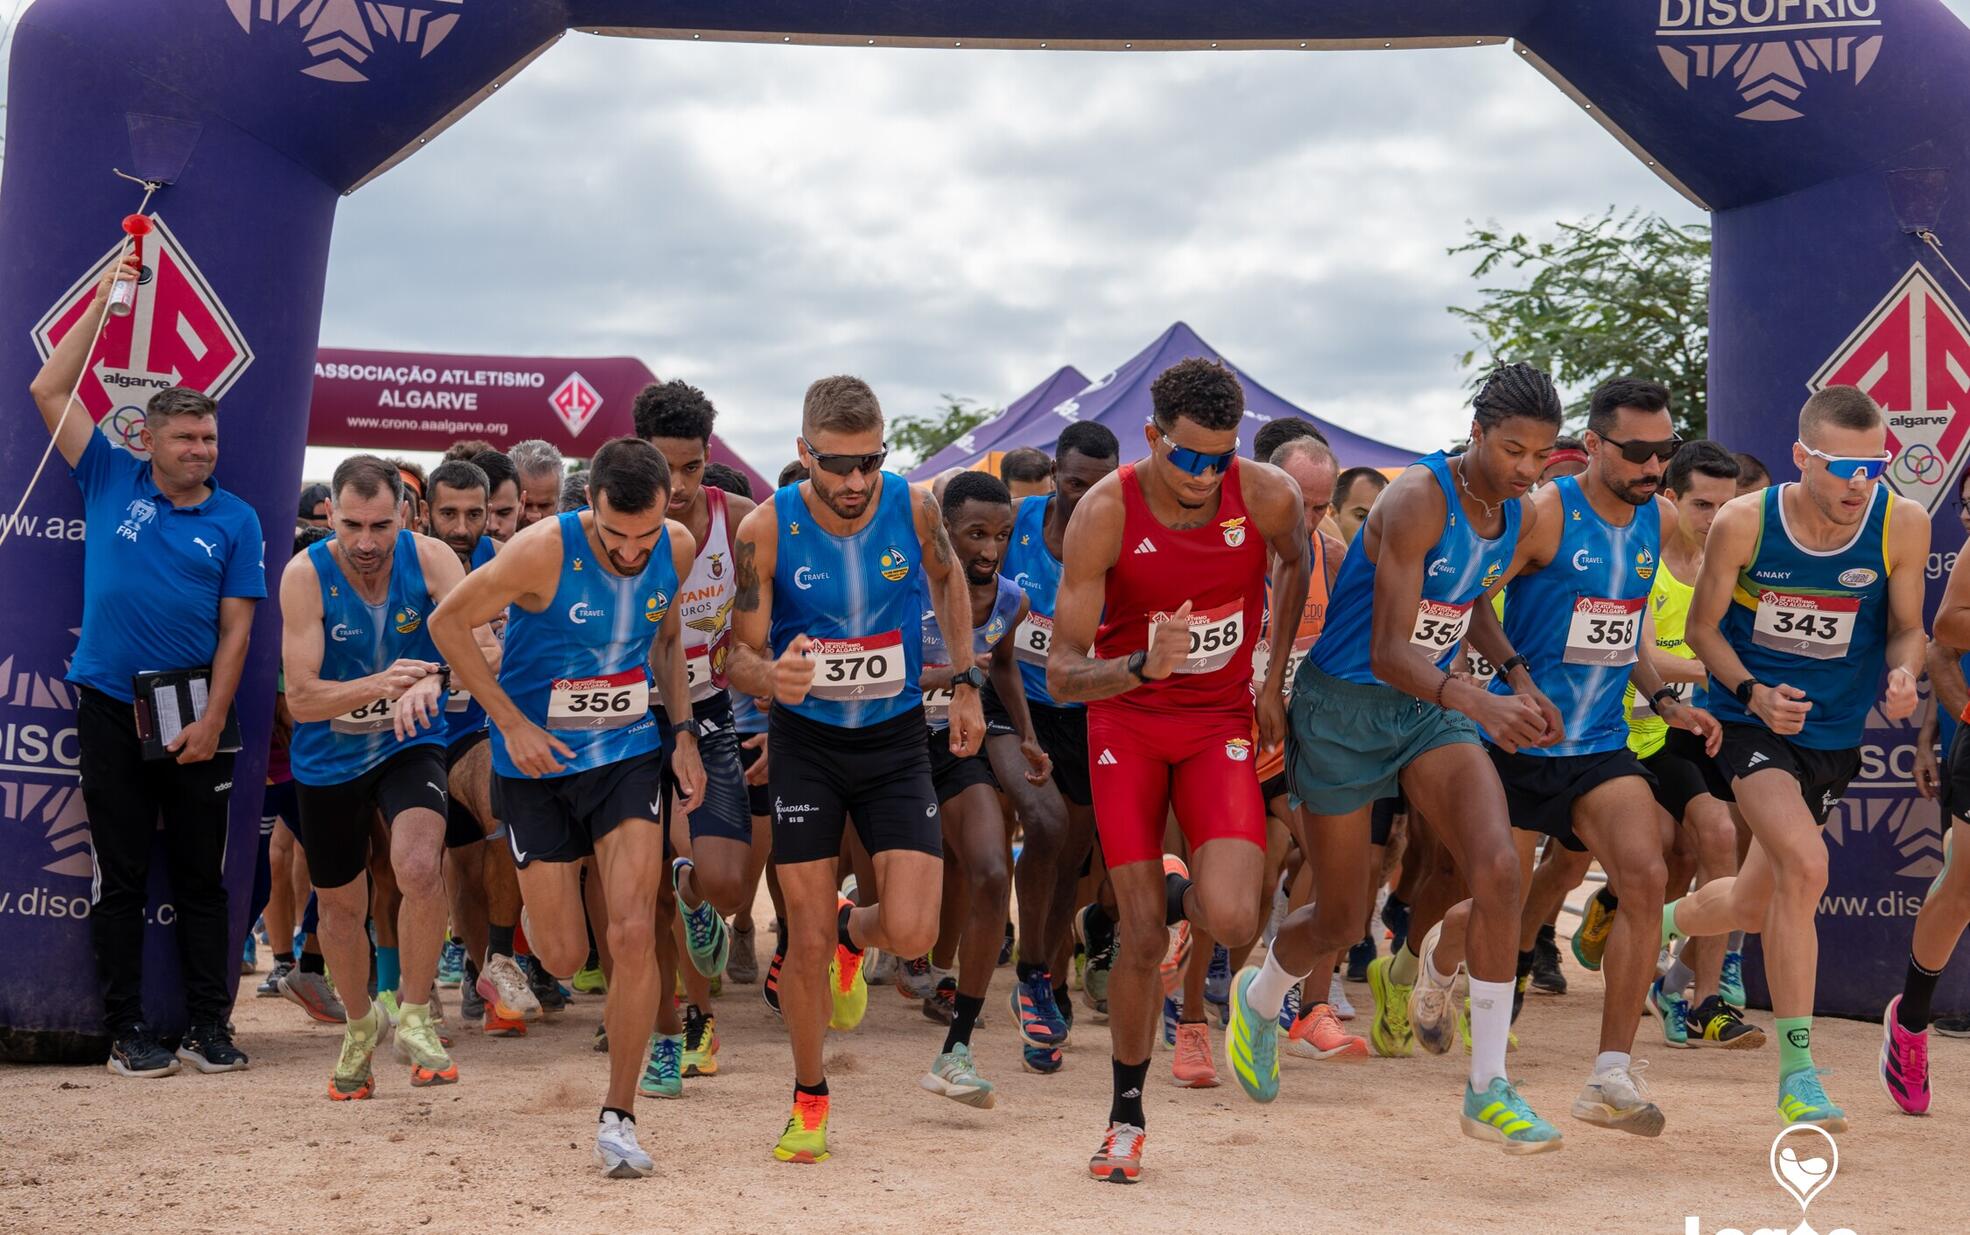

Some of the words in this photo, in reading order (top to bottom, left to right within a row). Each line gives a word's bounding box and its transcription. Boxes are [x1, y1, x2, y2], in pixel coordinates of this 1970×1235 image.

[103, 372, 171, 389] algarve
[314, 362, 436, 386] ASSOCIAÇÃO
[440, 369, 545, 388] ATLETISMO
[378, 388, 478, 411] ALGARVE
[1889, 415, 1948, 429] algarve
[116, 525, 137, 543] FPA
[1581, 556, 1604, 565] TRAVEL
[803, 572, 830, 581] TRAVEL
[1021, 579, 1042, 590] TRAVEL
[1756, 570, 1792, 580] ANAKY
[579, 609, 605, 617] TRAVEL
[1415, 619, 1463, 646] 352
[1587, 619, 1634, 645] 358
[1773, 611, 1839, 640] 343
[1029, 630, 1051, 652] 8
[825, 655, 888, 682] 370
[568, 691, 631, 713] 356
